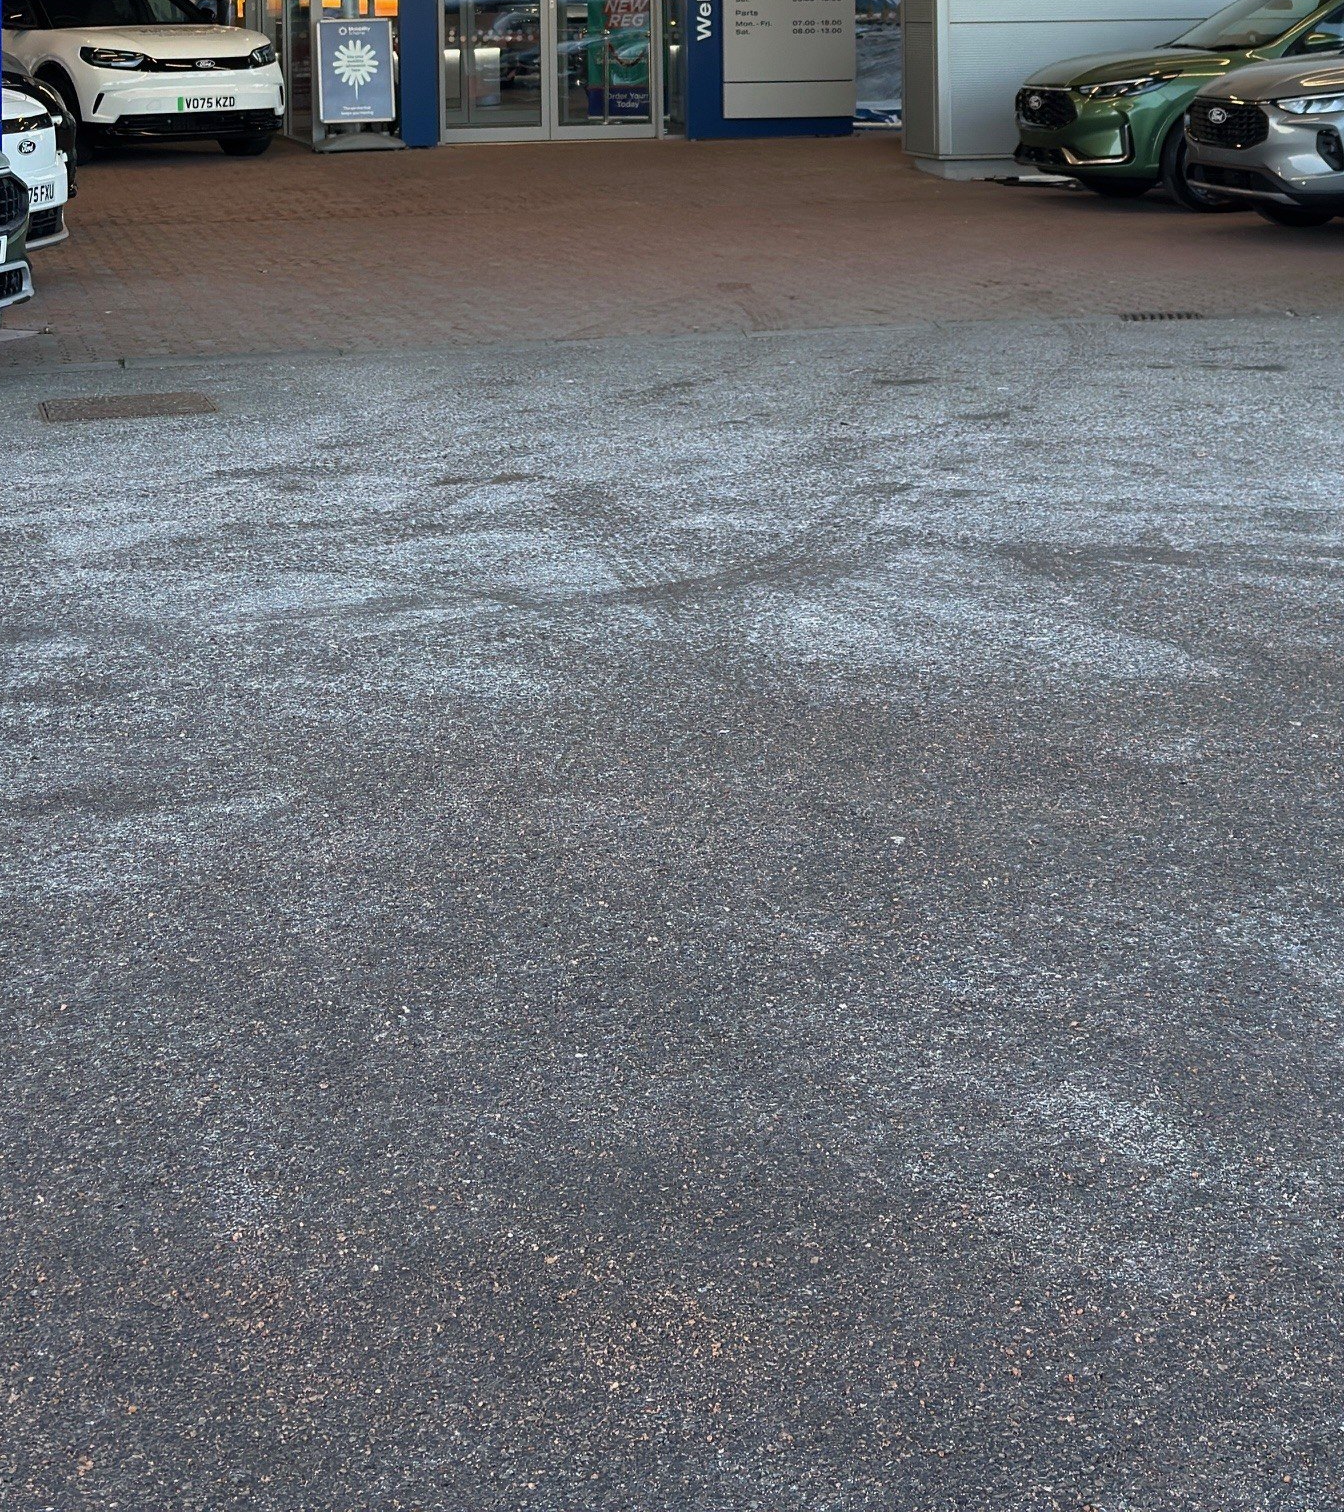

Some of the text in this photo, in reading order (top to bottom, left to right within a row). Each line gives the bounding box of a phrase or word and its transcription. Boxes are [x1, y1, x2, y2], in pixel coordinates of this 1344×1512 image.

[605, 0, 648, 13] NEW
[609, 14, 644, 27] REG
[185, 96, 236, 109] VO75 KZD
[616, 101, 640, 109] Today
[40, 184, 55, 202] FXU
